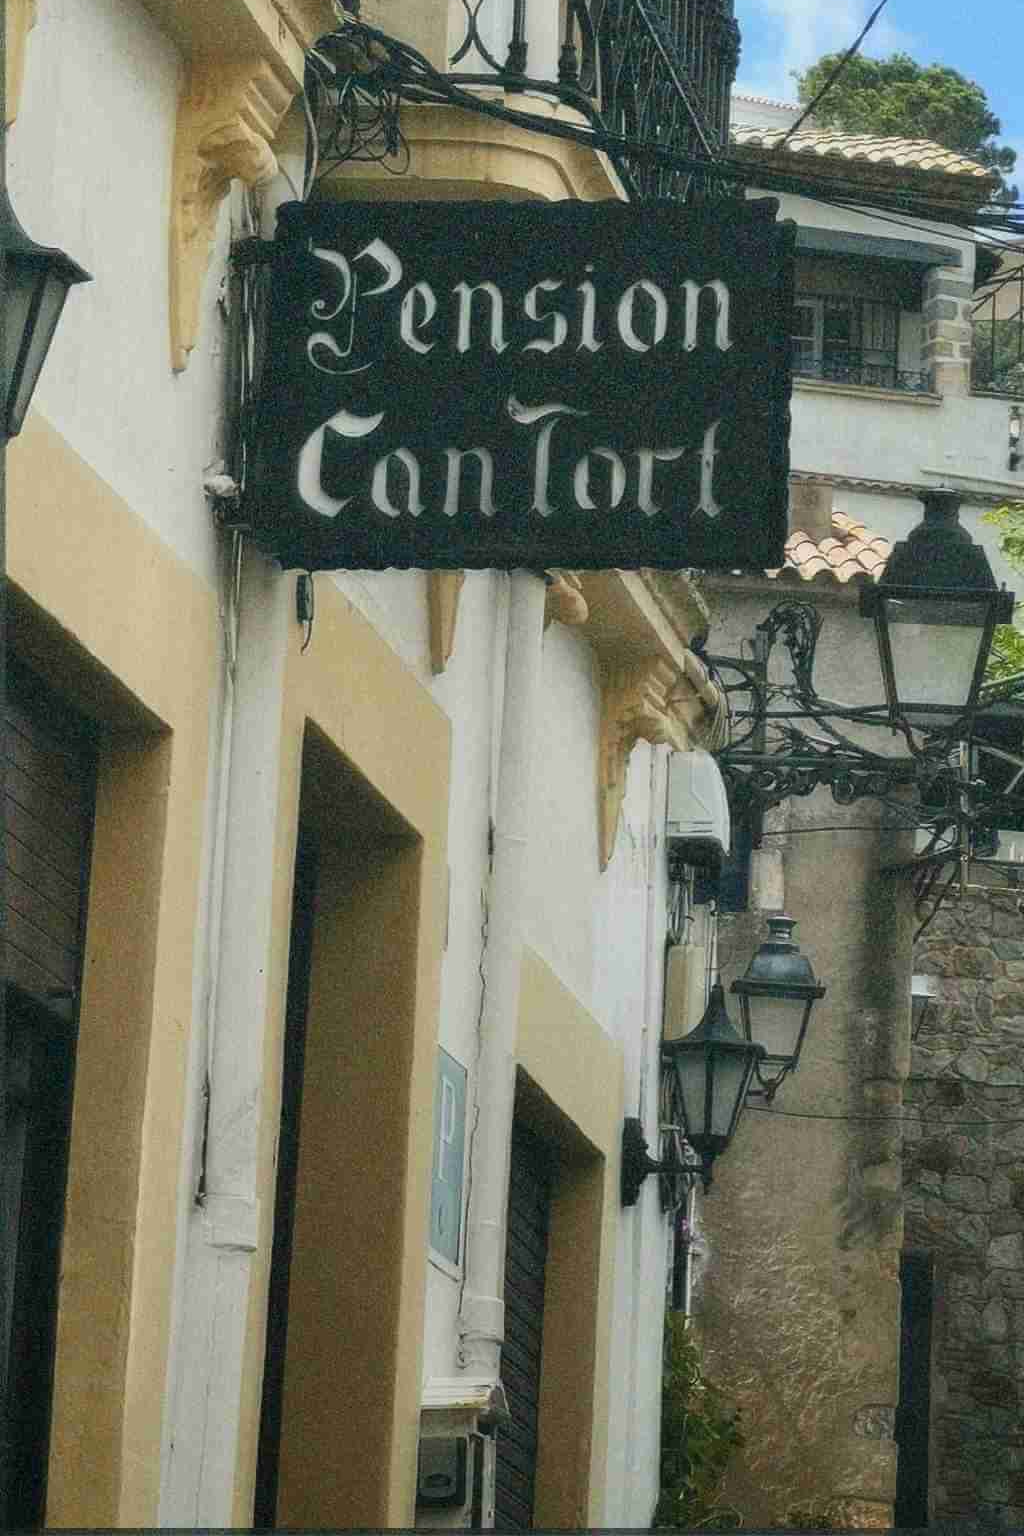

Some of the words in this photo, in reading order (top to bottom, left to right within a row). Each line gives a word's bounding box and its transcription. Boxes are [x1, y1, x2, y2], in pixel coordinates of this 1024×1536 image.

[308, 238, 733, 375] Pension
[297, 409, 498, 517] Can
[507, 394, 722, 517] Tort
